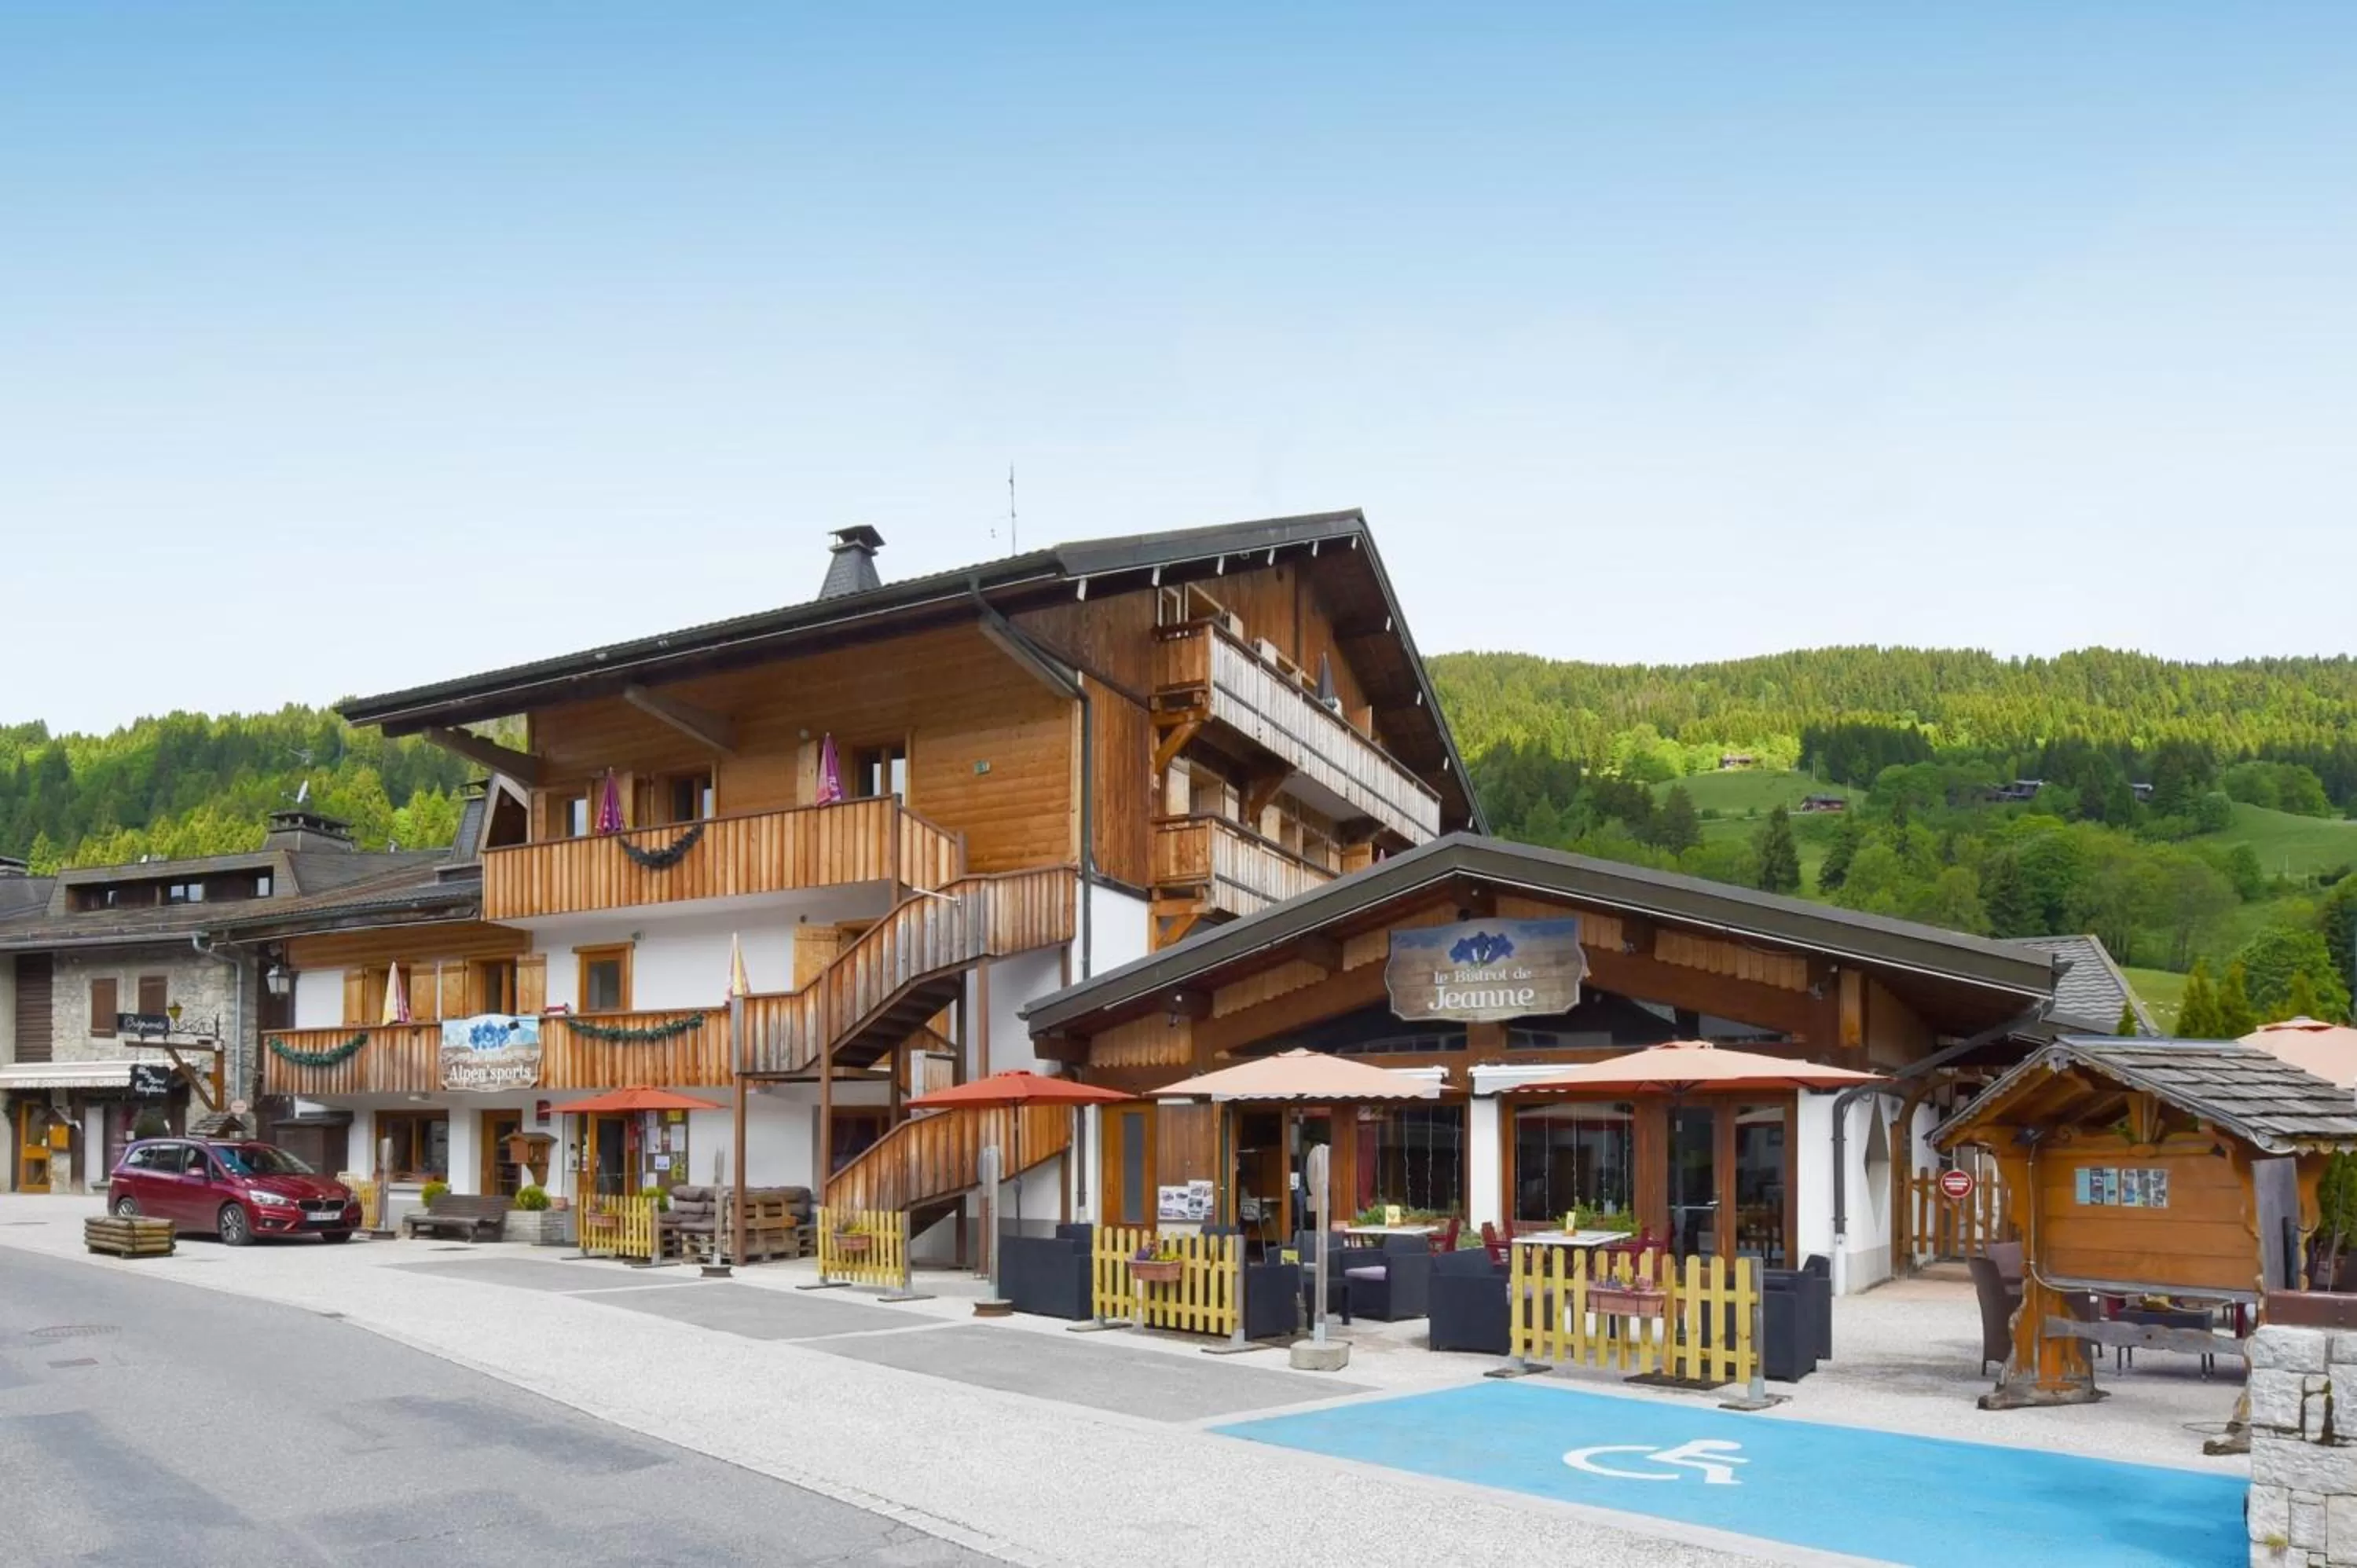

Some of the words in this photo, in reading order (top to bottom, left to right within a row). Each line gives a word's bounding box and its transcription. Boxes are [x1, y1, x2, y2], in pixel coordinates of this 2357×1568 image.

[1453, 967, 1508, 983] Bistrot
[1512, 967, 1532, 980] de
[1427, 985, 1534, 1010] Jeanne
[449, 1064, 532, 1088] Alpen'sports
